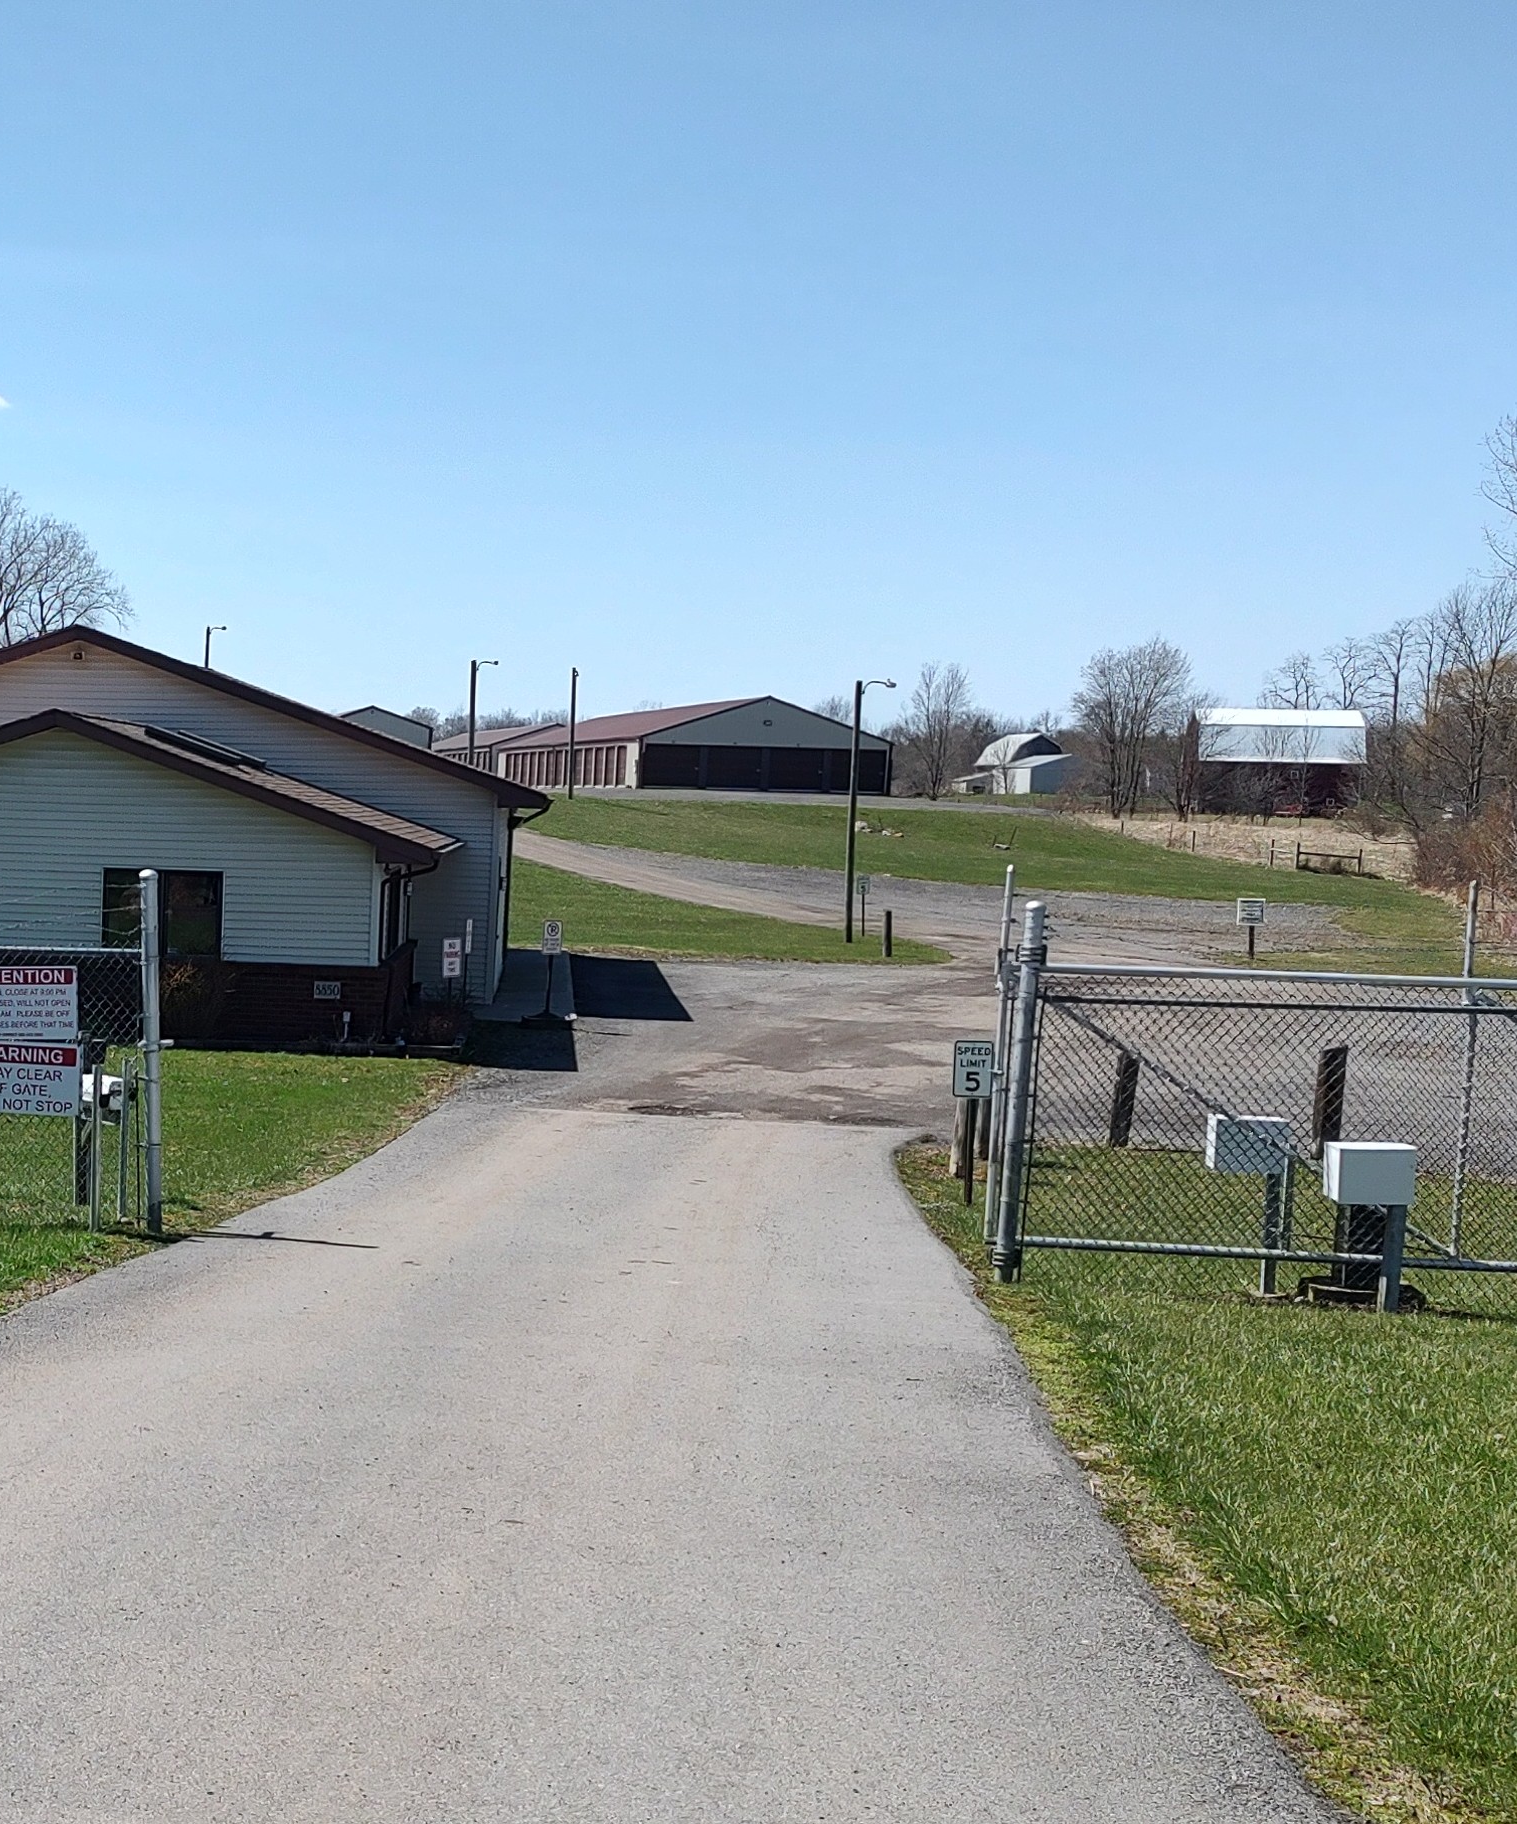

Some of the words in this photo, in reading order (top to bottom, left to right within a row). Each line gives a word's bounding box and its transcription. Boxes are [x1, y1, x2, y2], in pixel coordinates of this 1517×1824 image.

[5, 988, 28, 996] CLOSE
[30, 988, 38, 996] AT
[17, 999, 33, 1007] WILL
[34, 999, 49, 1007] NOT
[51, 999, 71, 1007] OPEN
[16, 1010, 43, 1018] PLEASE
[44, 1010, 54, 1018] BE
[56, 1010, 71, 1018] OFF
[957, 1046, 991, 1056] SPEED
[960, 1059, 986, 1068] LIMIT
[16, 1068, 63, 1082] CLEAR
[965, 1071, 980, 1092] 5
[12, 1083, 52, 1098] GATE,
[2, 1098, 32, 1111] NOT
[35, 1100, 73, 1113] STOP
